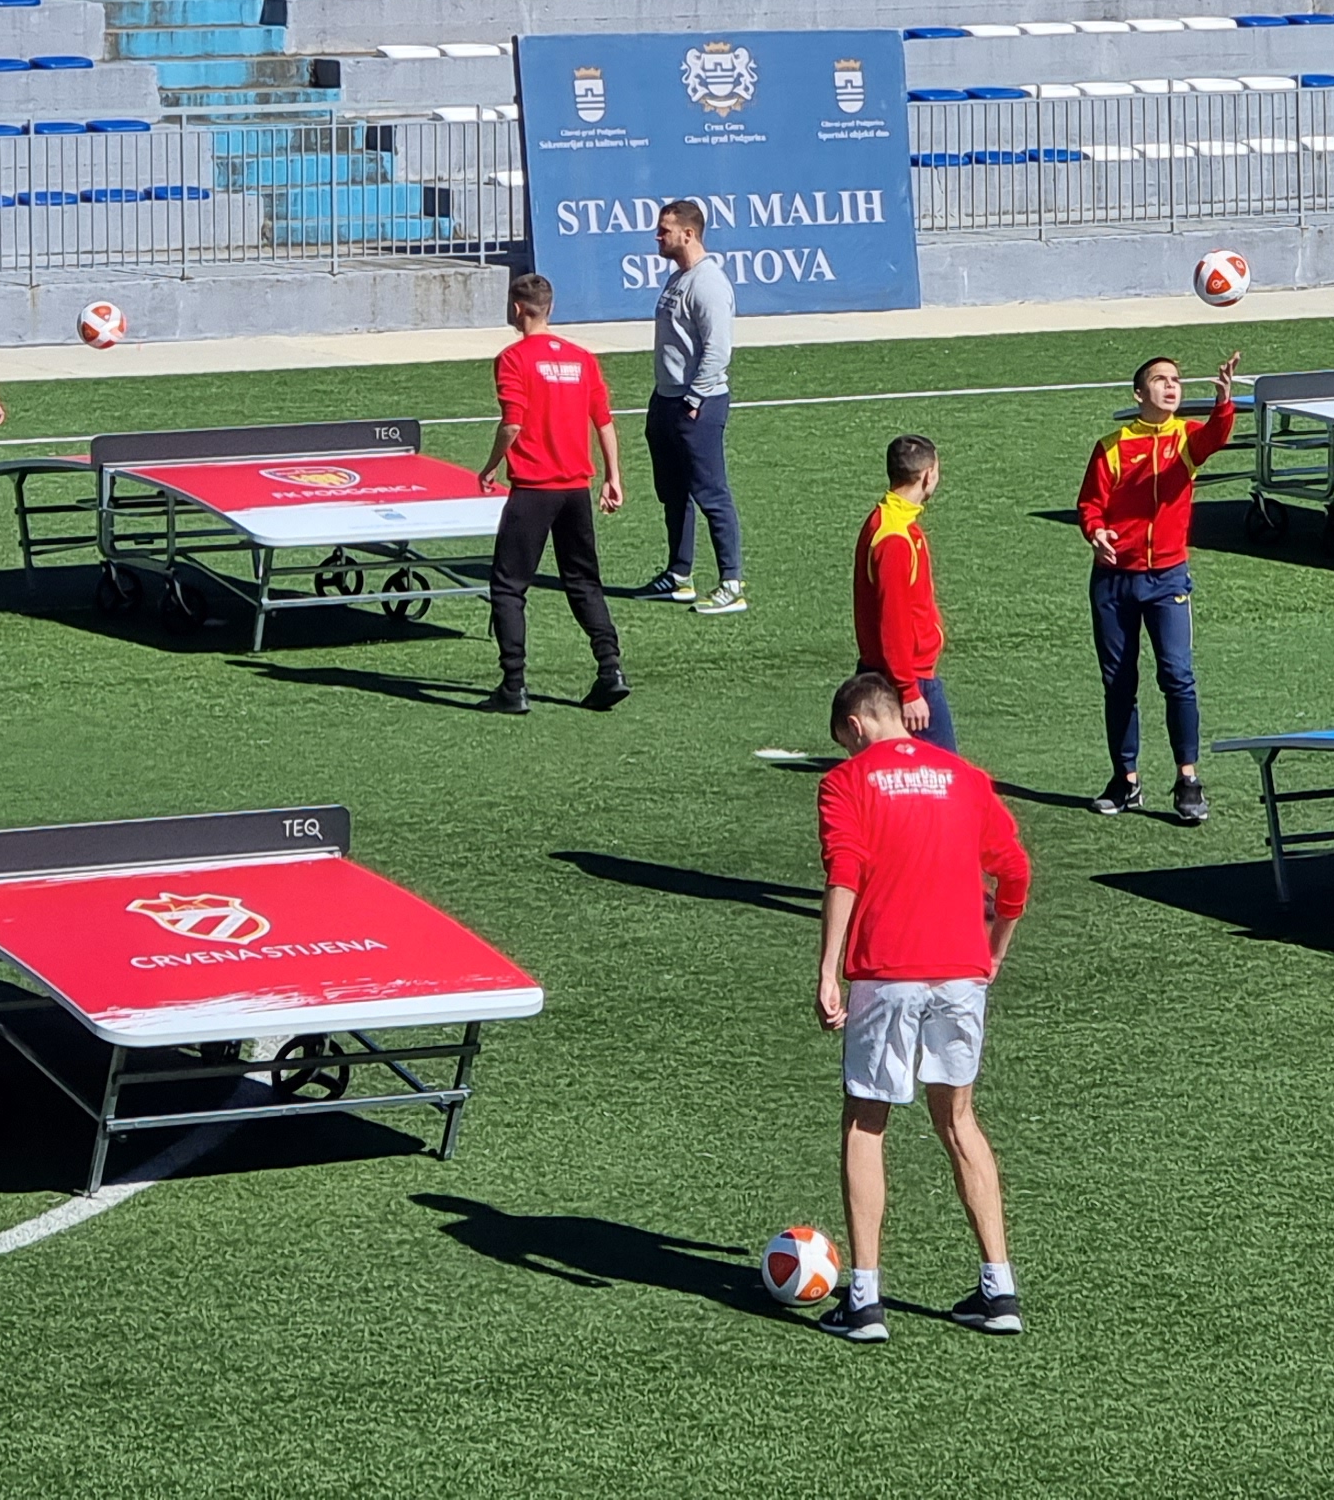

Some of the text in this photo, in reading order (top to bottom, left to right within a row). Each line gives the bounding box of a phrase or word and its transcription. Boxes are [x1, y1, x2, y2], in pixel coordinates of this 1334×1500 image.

[556, 189, 886, 236] STADN MALIH
[621, 247, 837, 290] SPTOVA
[374, 426, 403, 443] TEQ
[271, 484, 428, 500] FK PODGORICA
[282, 817, 323, 841] TEQ
[130, 938, 388, 970] CRVENA STIJENA
